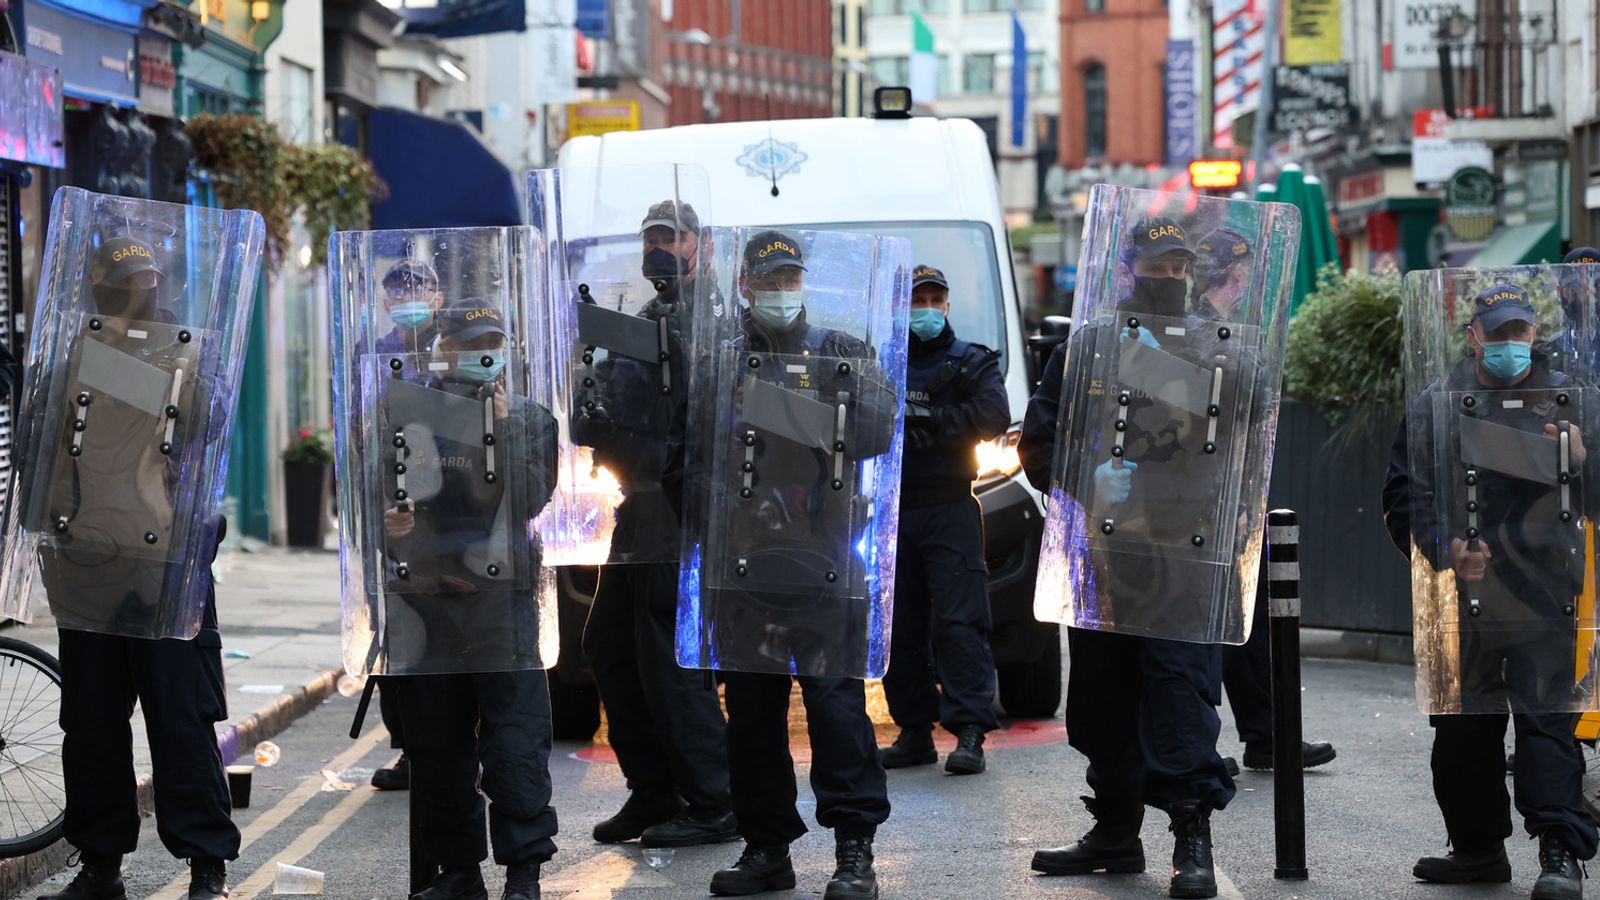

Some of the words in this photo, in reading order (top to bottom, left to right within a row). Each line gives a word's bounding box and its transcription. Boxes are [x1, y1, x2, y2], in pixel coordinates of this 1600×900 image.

[112, 245, 151, 262] GARDA
[758, 241, 796, 258] GARDA
[1485, 292, 1523, 305] GARDA
[465, 308, 499, 321] GARDA
